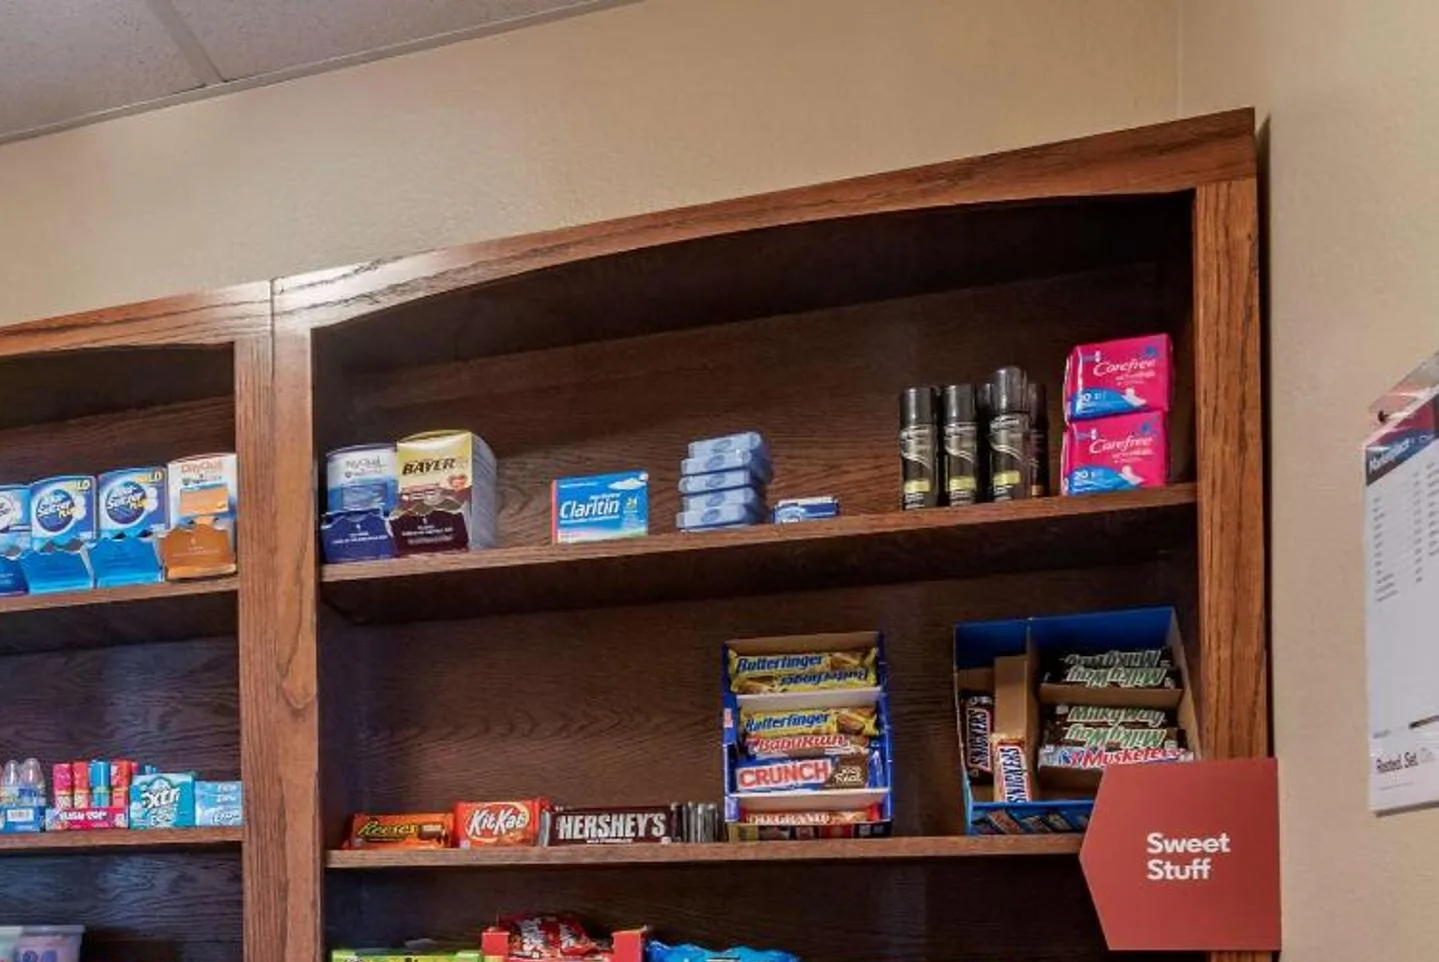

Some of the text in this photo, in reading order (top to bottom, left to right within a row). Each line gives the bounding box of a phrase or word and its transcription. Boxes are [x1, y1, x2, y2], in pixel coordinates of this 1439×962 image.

[1094, 358, 1156, 376] Carefree
[1089, 435, 1153, 454] Carefree
[402, 458, 456, 475] BAYER
[560, 498, 620, 518] Claritin
[736, 654, 824, 674] Butterfinger
[746, 713, 830, 732] Butterfinger
[740, 762, 829, 787] CRUNCH
[560, 813, 666, 840] HERSHEY'S
[1146, 832, 1230, 854] Sweet
[1146, 858, 1211, 880] Stuff
